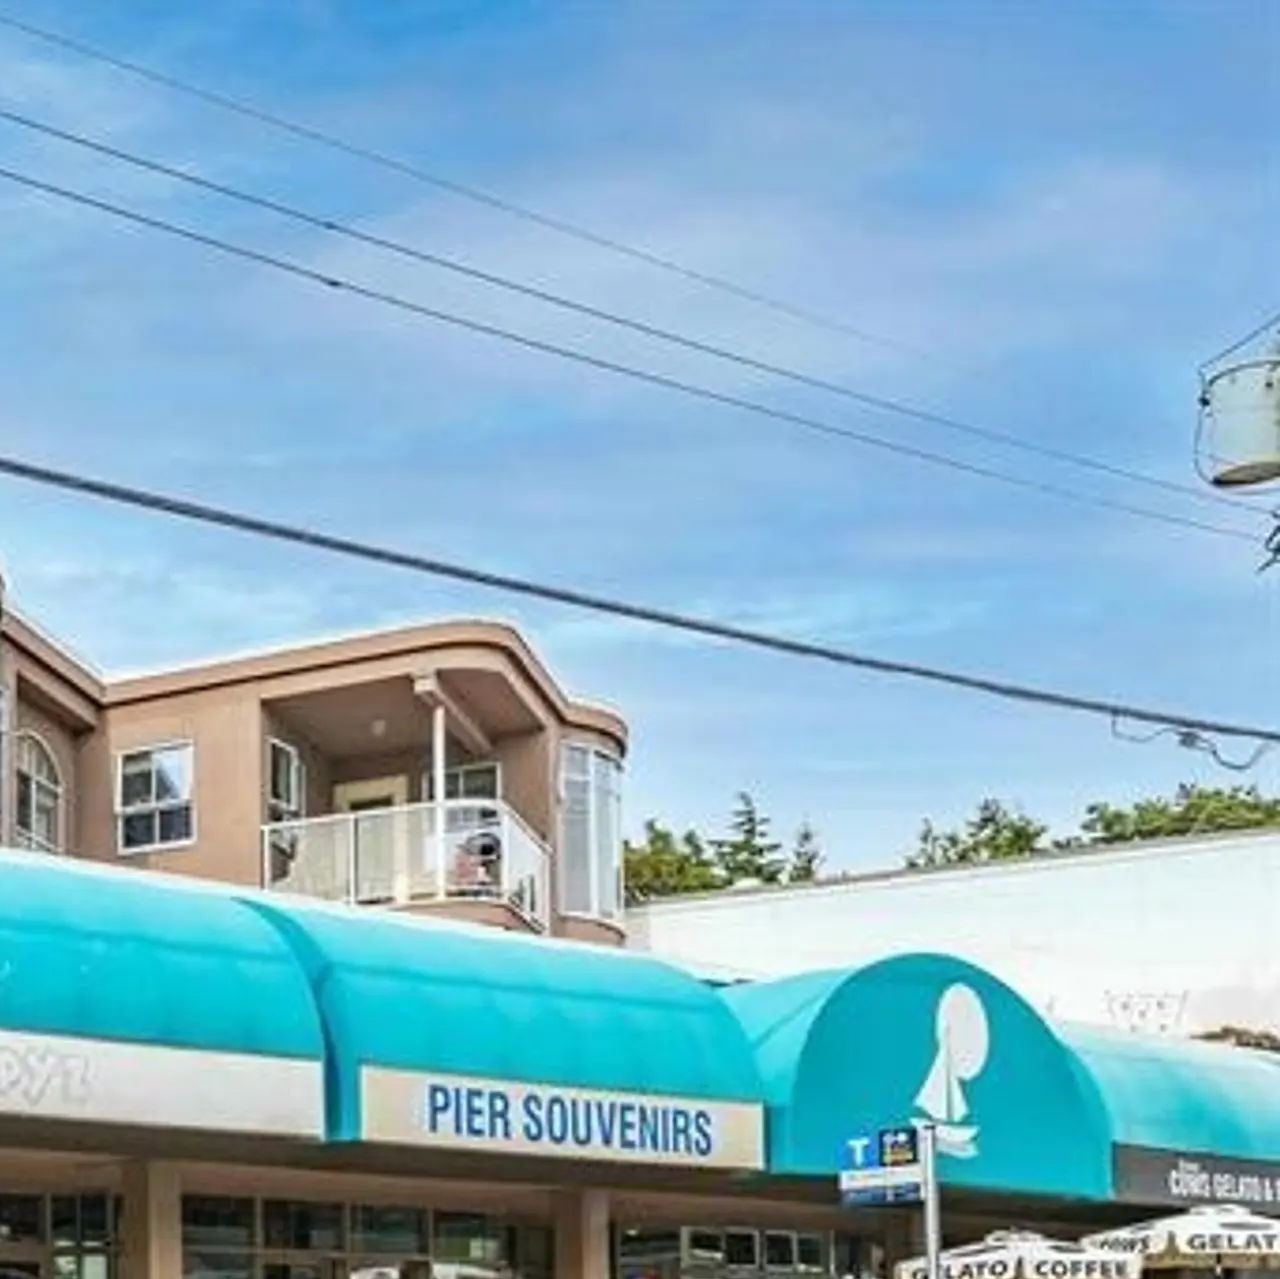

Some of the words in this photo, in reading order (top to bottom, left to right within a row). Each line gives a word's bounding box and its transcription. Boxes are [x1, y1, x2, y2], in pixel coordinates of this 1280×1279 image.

[427, 1084, 513, 1142] PIER
[522, 1090, 713, 1157] SOUVENIRS
[1035, 1259, 1128, 1278] COFFEE
